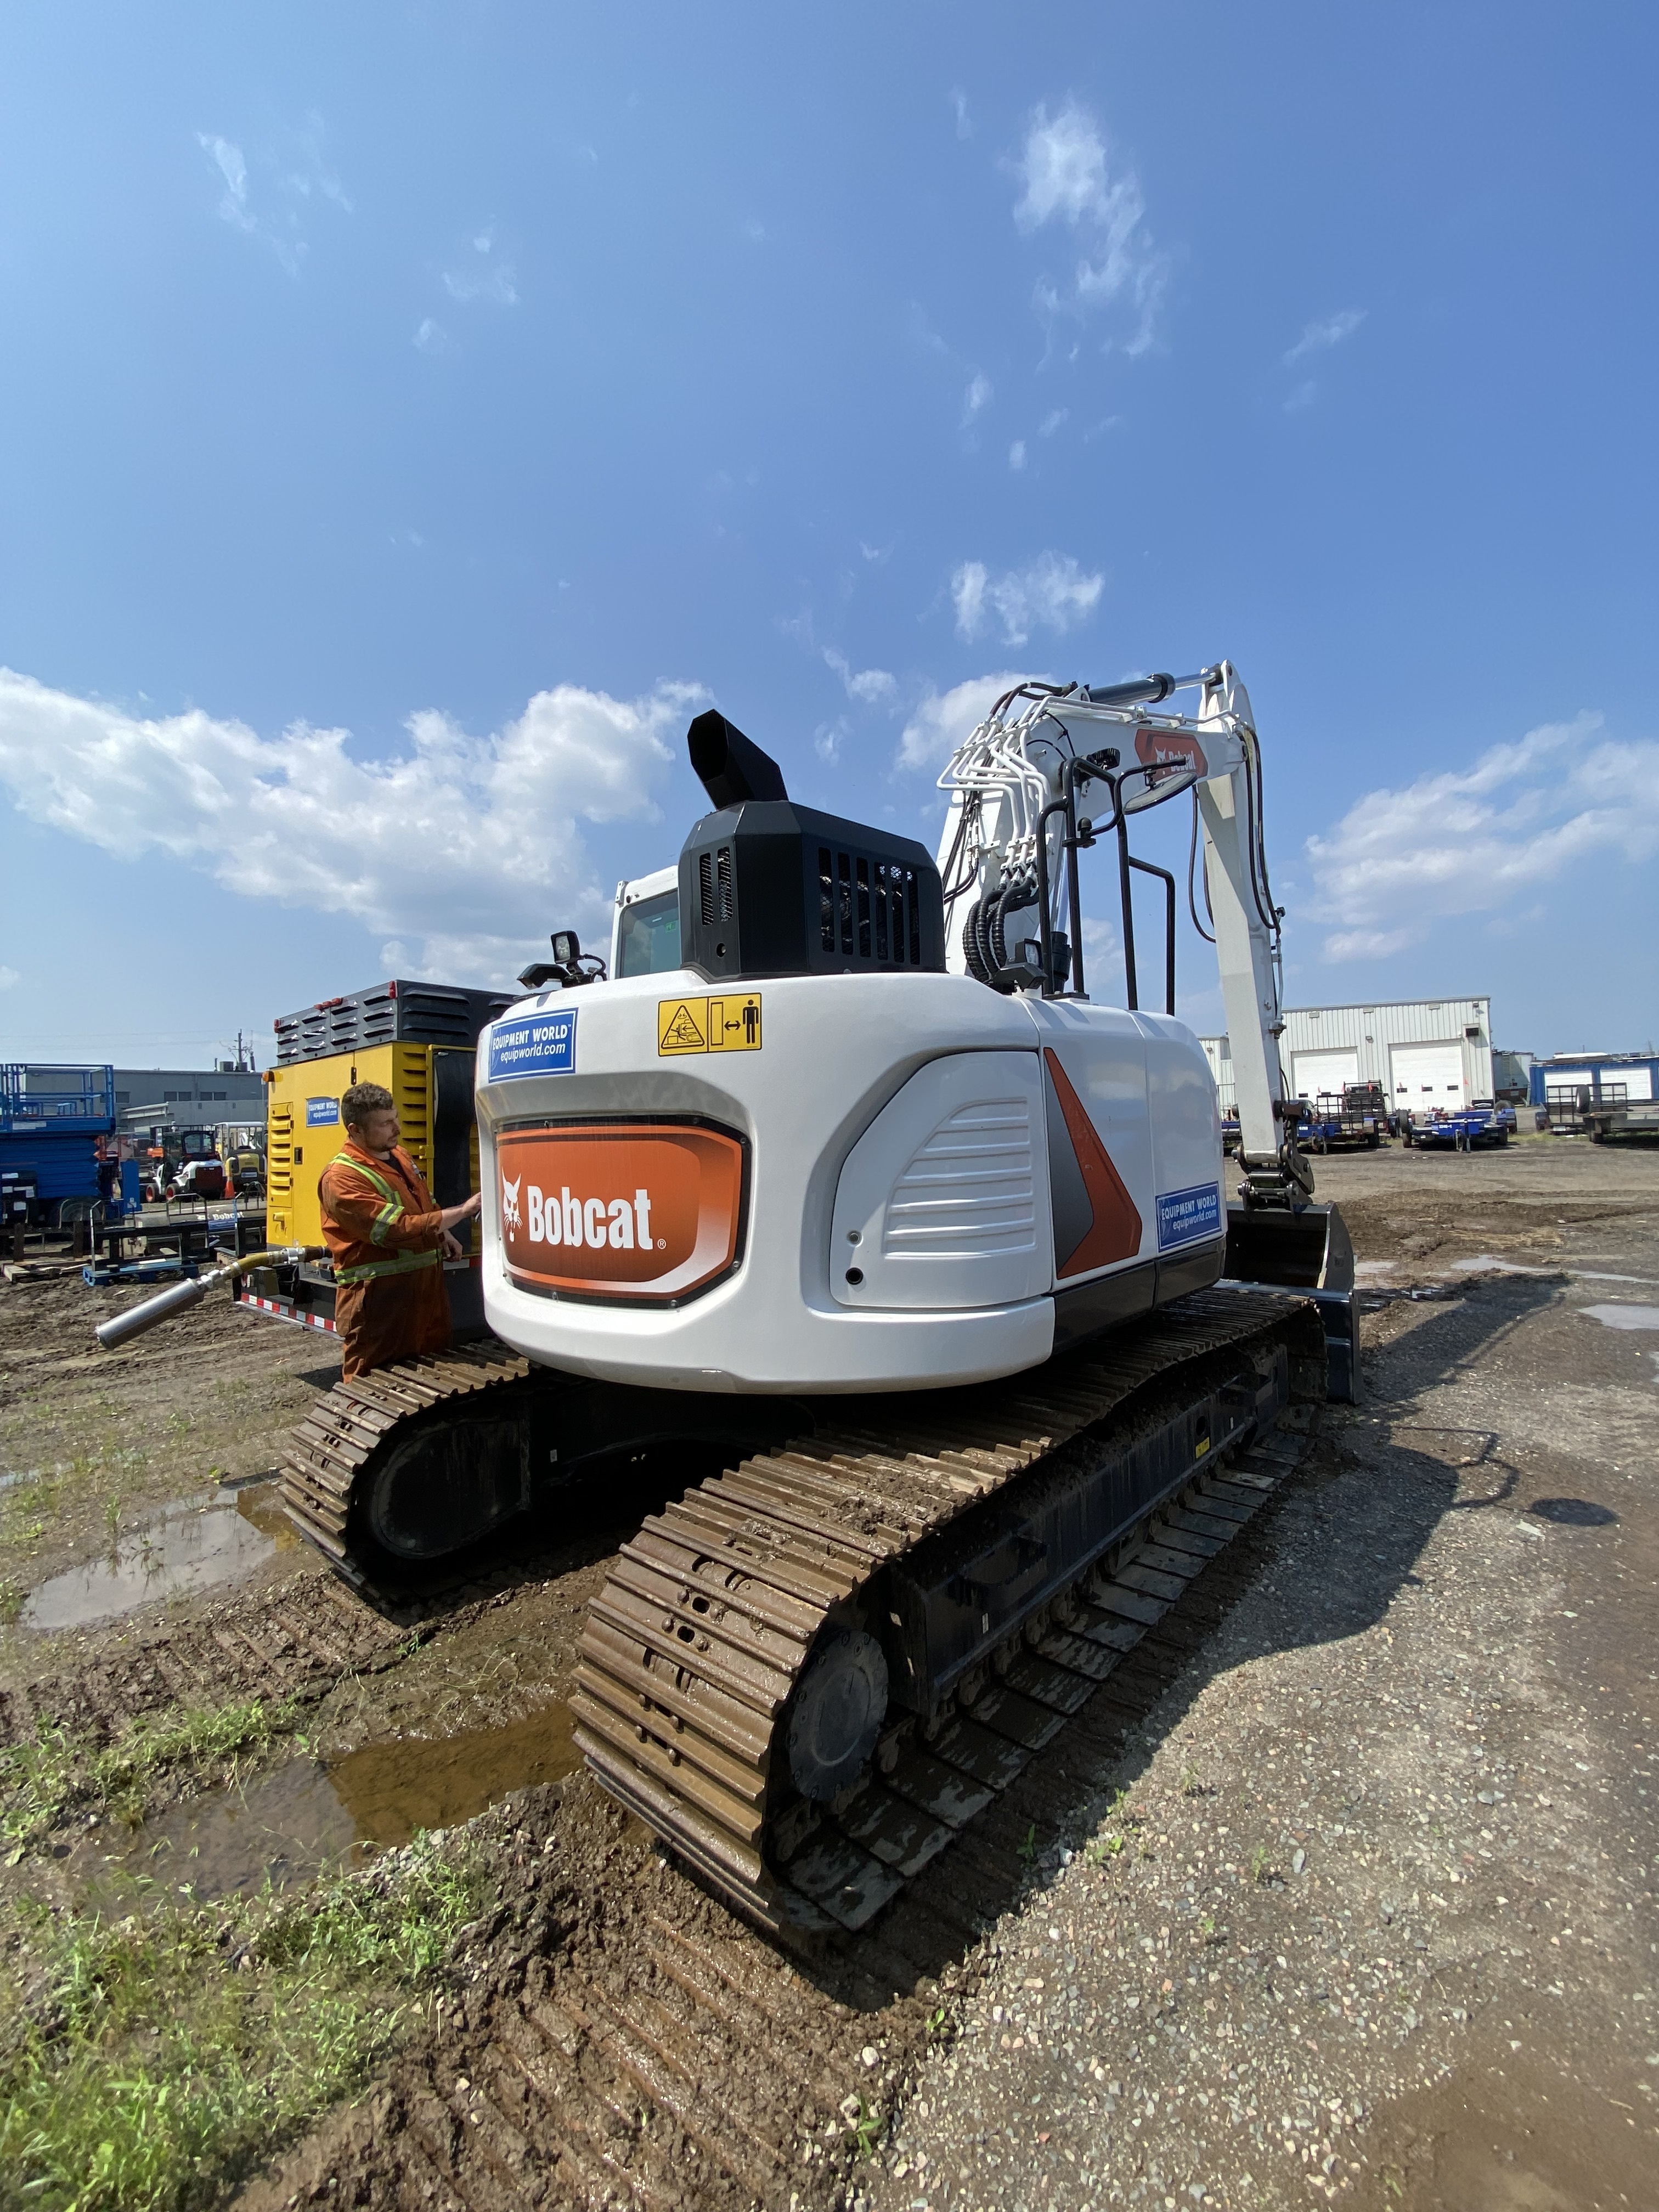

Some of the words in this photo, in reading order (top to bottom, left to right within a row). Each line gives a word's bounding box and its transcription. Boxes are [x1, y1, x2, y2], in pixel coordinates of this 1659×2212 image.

[1168, 750, 1196, 772] Bobcat
[493, 1030, 529, 1051] EQUIPMENT
[533, 1024, 568, 1042] WORLD
[500, 1043, 566, 1064] equipworld.com
[527, 1185, 653, 1250] Bobcat
[1161, 1200, 1195, 1221] EQUIPMENT
[1197, 1194, 1217, 1210] WORLD
[1173, 1209, 1217, 1231] equipworld.com
